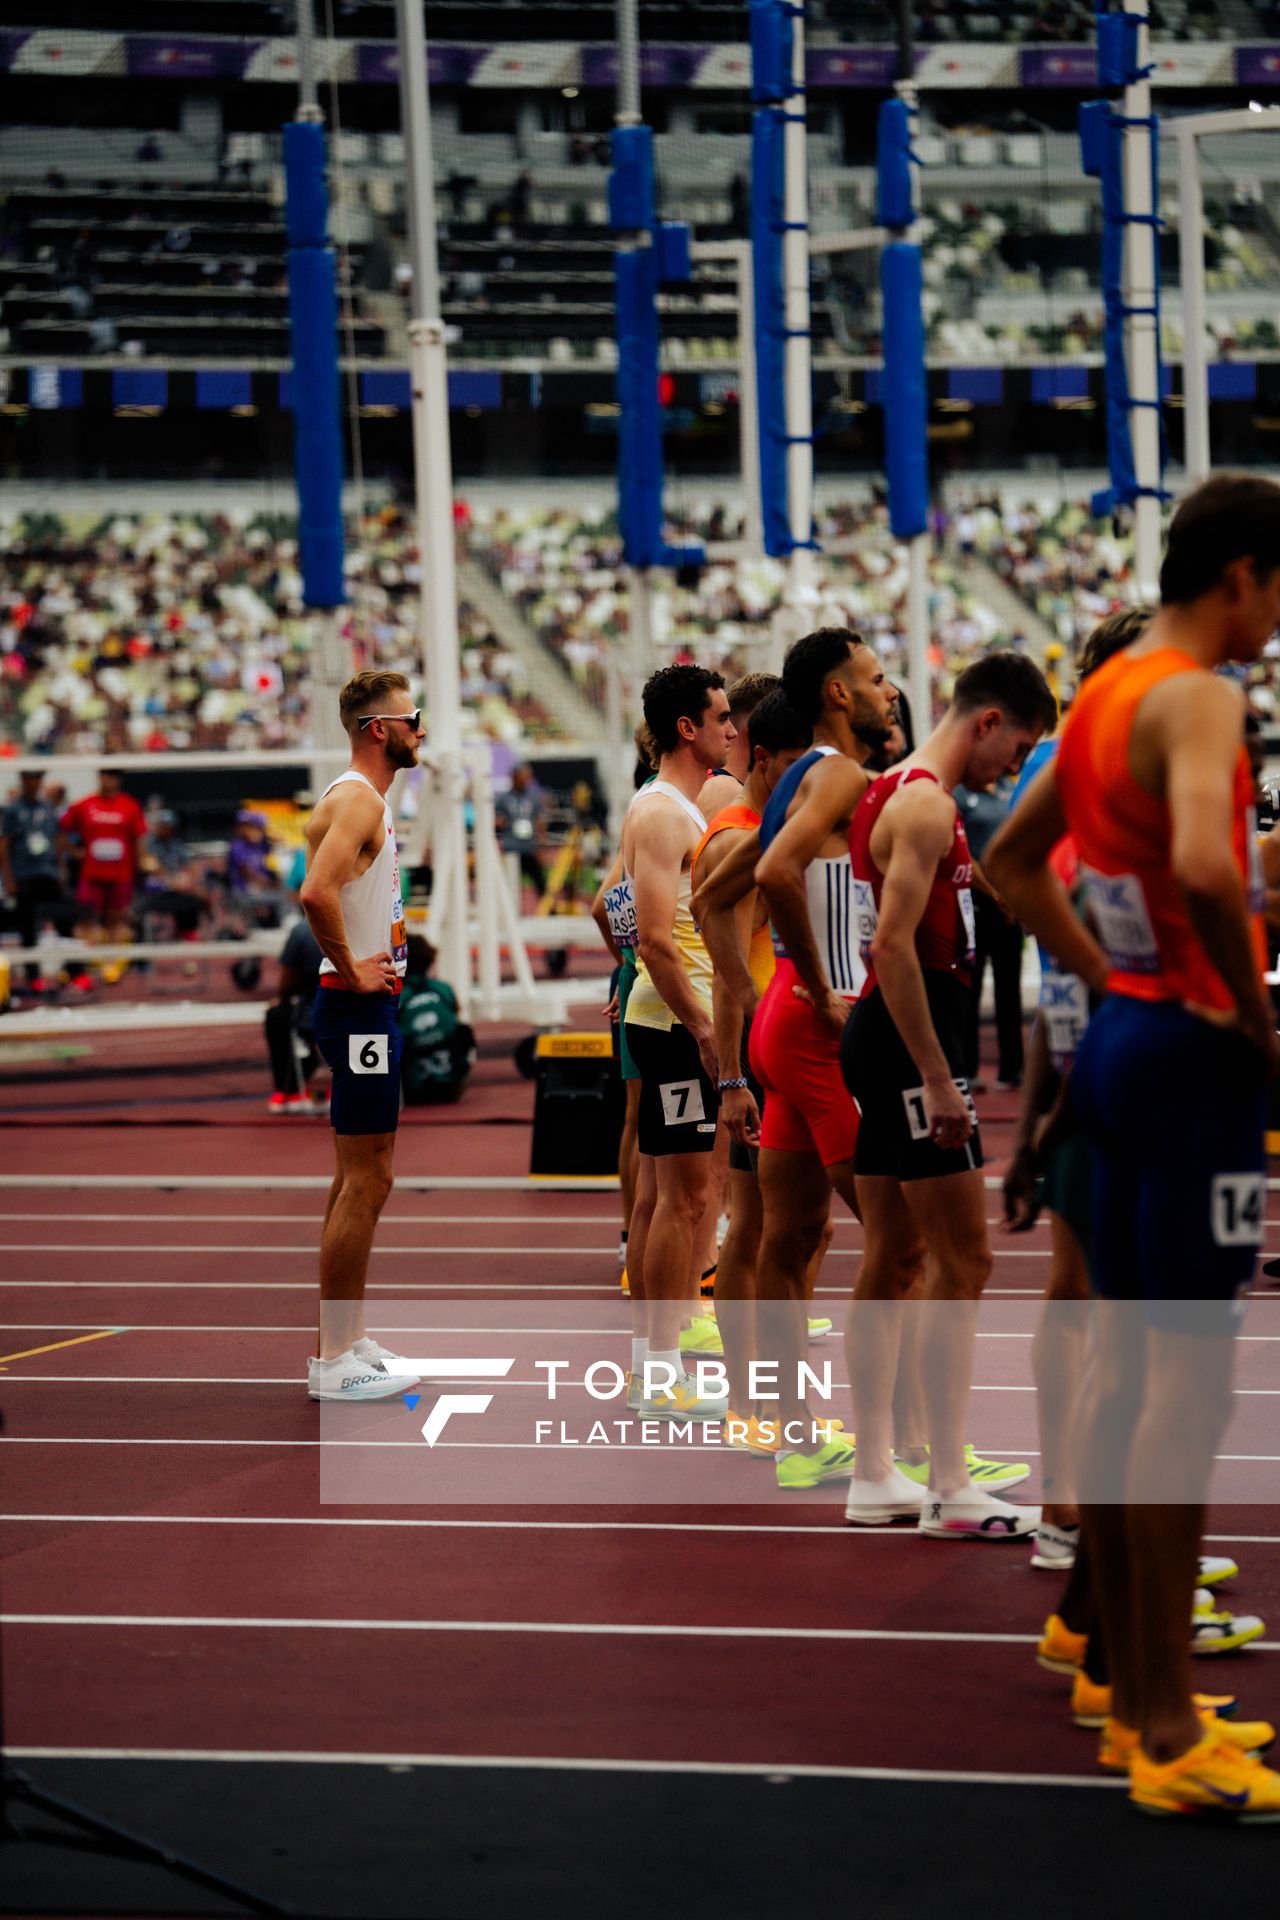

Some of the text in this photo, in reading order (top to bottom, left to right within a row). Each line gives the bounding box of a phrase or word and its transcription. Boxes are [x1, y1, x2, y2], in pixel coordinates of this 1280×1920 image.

[360, 1040, 379, 1068] 6
[671, 1087, 690, 1118] 7
[909, 1096, 928, 1130] 1
[1221, 1186, 1262, 1233] 14
